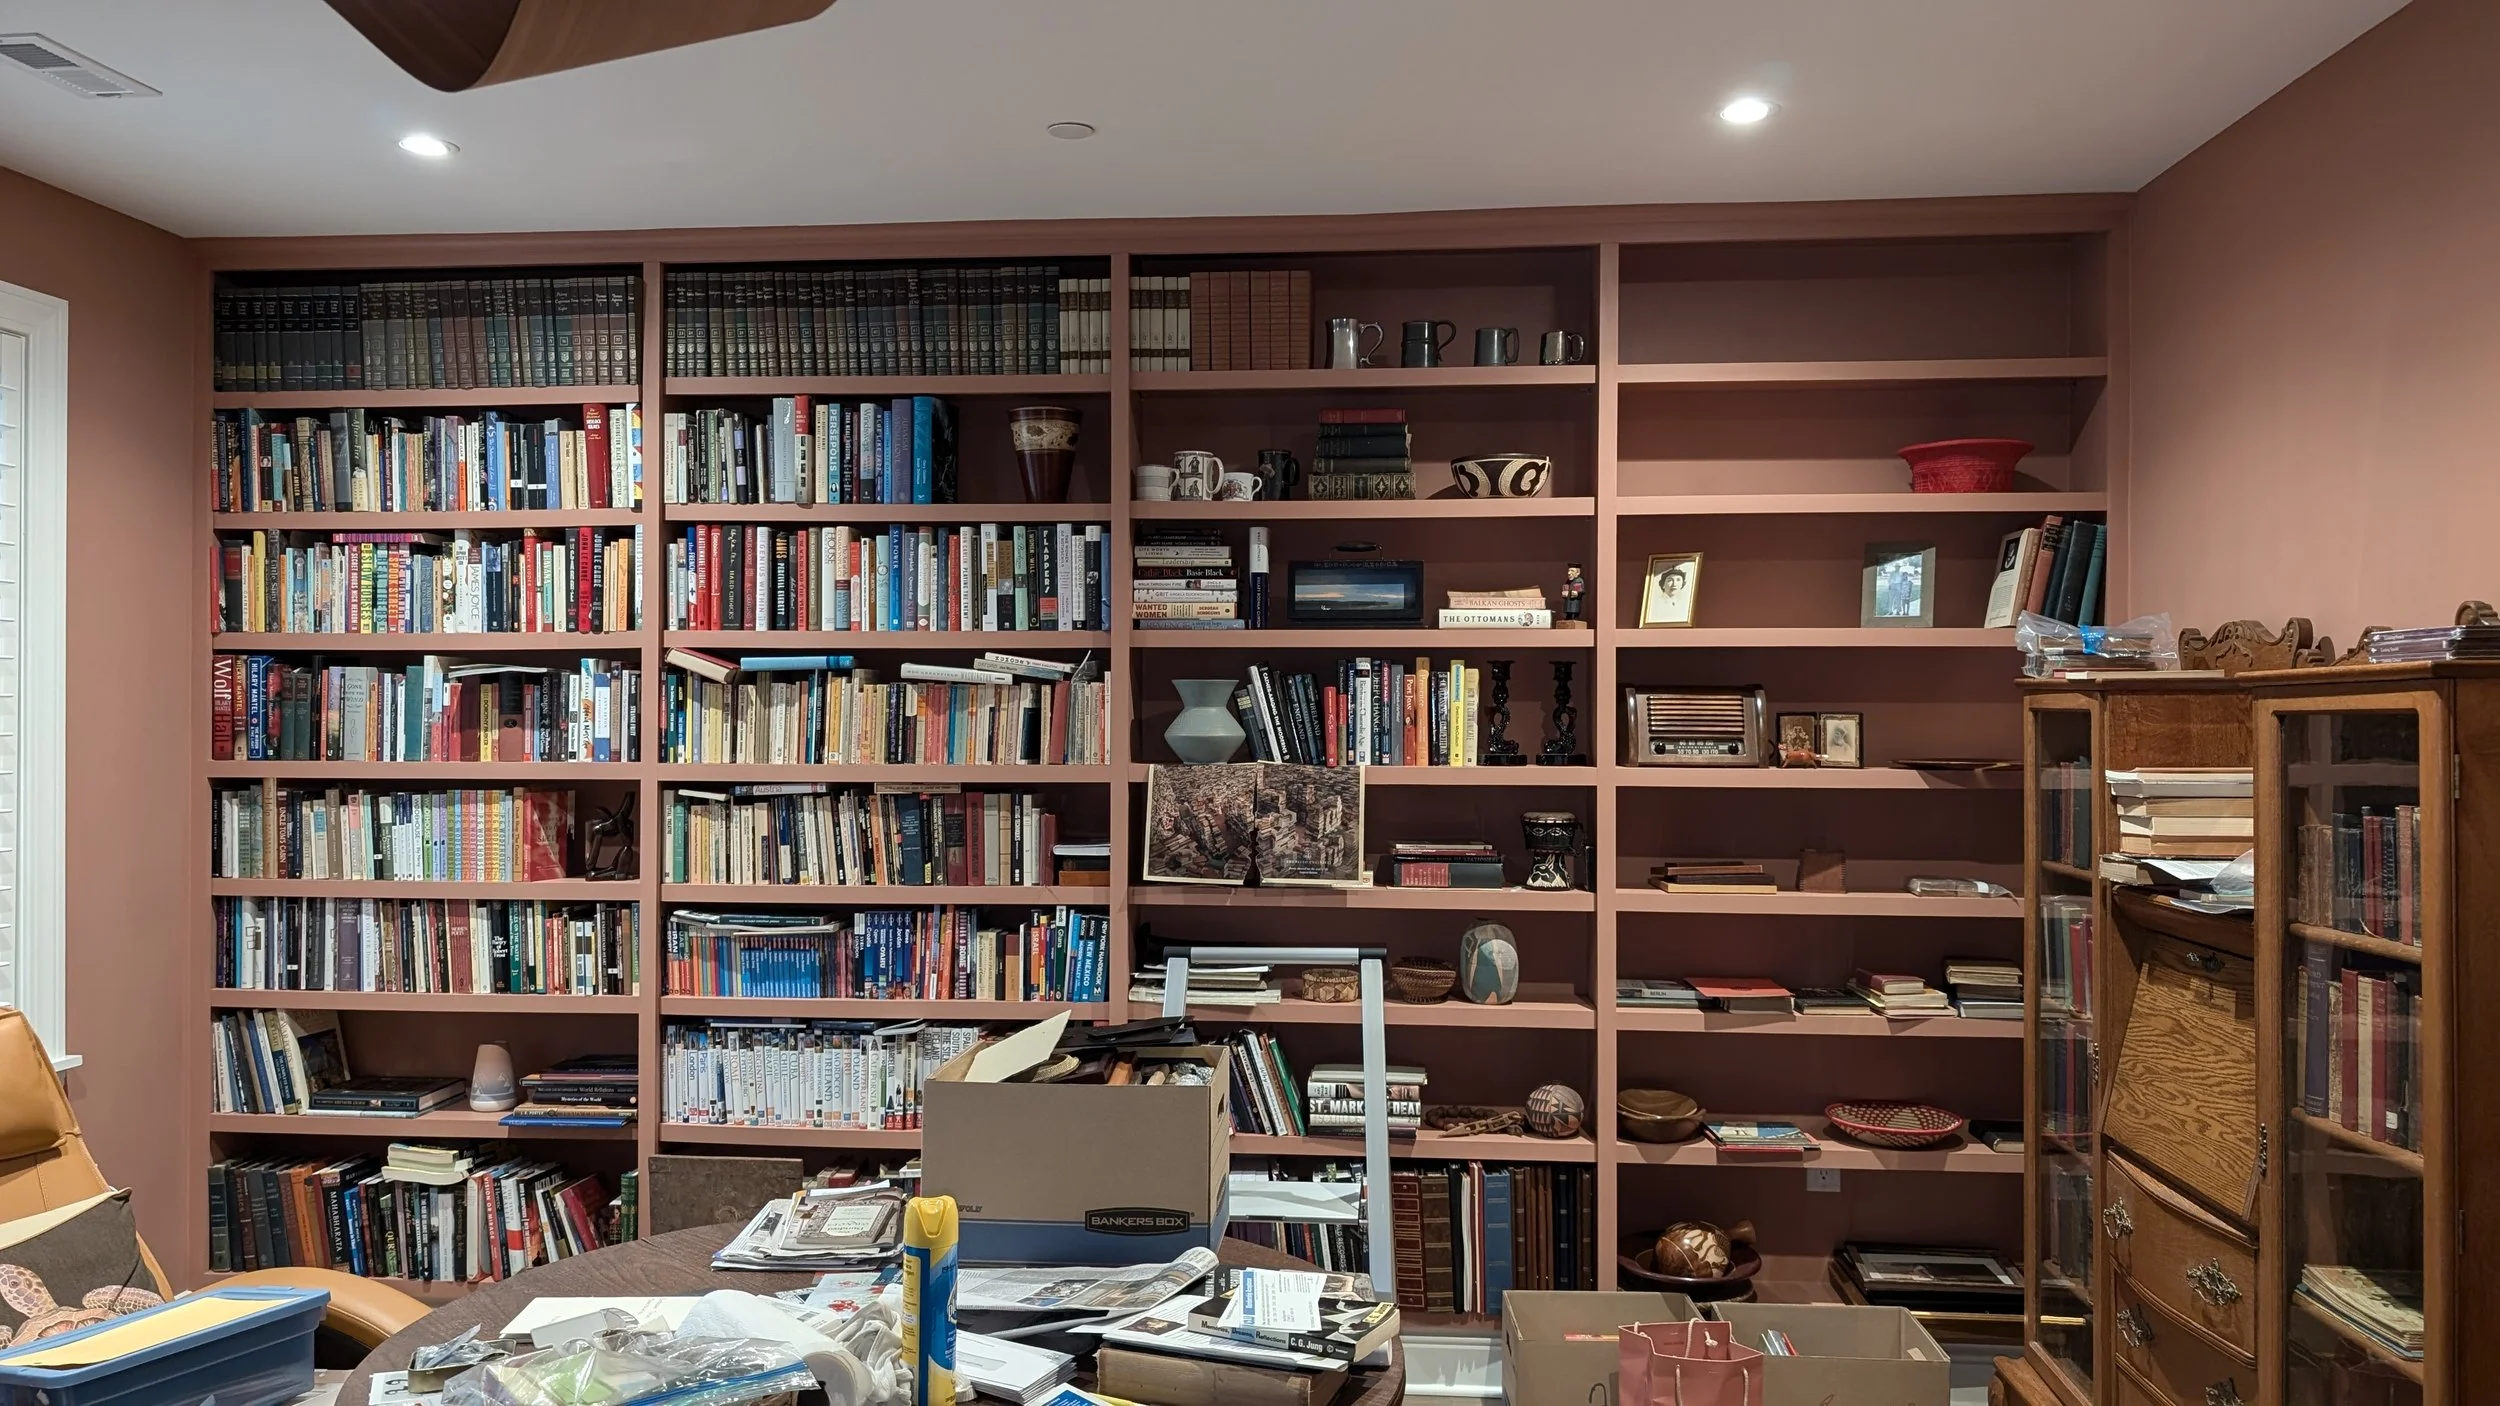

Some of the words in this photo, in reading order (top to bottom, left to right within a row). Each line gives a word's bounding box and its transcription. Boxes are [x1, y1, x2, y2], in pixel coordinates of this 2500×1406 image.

[351, 418, 360, 439] After
[829, 408, 838, 472] PERSEPOLIS
[862, 408, 872, 452] Windswept
[352, 444, 361, 460] Fire
[581, 534, 589, 553] JOHN
[593, 534, 602, 554] JOHN
[775, 537, 787, 559] JAMES
[827, 531, 836, 565] HOUSE
[892, 529, 900, 542] SEA
[908, 537, 916, 550] Peter
[360, 555, 371, 582] SLOW
[581, 554, 589, 563] LE
[594, 555, 602, 563] LE
[892, 542, 900, 569] POWER
[907, 551, 916, 572] Hopkirk
[270, 559, 280, 580] Little
[375, 556, 386, 582] REAL
[388, 556, 398, 585] SPOOK
[470, 565, 481, 592] JAMES
[543, 554, 552, 585] HAVANA
[776, 562, 785, 589] PERCIVAL
[1186, 568, 1204, 577] Basic
[1205, 568, 1224, 577] Black
[270, 582, 280, 602] Saint
[361, 584, 372, 621] HORSES
[376, 585, 387, 623] TIGERS
[388, 587, 399, 620] STREET
[776, 590, 785, 616] EVERETT
[470, 592, 480, 620] JOYCE
[214, 659, 232, 700] Wolf
[250, 662, 258, 688] HILARY
[1372, 672, 1382, 695] DEEP
[251, 689, 259, 715] MANTEL
[1372, 695, 1382, 733] CHANGE
[1406, 695, 1414, 711] JOAN
[214, 714, 231, 743] Hall
[1267, 693, 1278, 715] AMONG
[1274, 726, 1288, 754] MODERNS
[1292, 703, 1305, 740] ENGLAND
[1309, 702, 1321, 736] IRELAND
[754, 784, 783, 794] Austria
[264, 796, 273, 817] Help
[514, 924, 519, 932] ON
[1057, 928, 1065, 948] Ghana
[1032, 930, 1040, 956] ISRAEL
[1085, 941, 1094, 959] NEW
[1098, 935, 1107, 951] YORK
[1083, 960, 1092, 987] MEXICO
[1095, 951, 1106, 986] HANDBOOK
[931, 1031, 941, 1060] ICELAND
[942, 1031, 951, 1045] THE
[952, 1031, 960, 1054] SOUTH
[731, 1054, 739, 1083] ROME
[755, 1048, 764, 1094] ARGENTINA
[790, 1053, 798, 1080] CUBA
[833, 1052, 841, 1099] MOROCCO
[844, 1051, 852, 1076] PERU
[824, 1057, 832, 1102] IRELAND
[869, 1052, 879, 1104] CALIFORNIA
[1330, 1100, 1364, 1114] MARK
[330, 1190, 344, 1253] MAHABHARATA
[486, 1204, 492, 1216] OR
[1091, 1216, 1154, 1226] BANKERS
[1156, 1217, 1184, 1227] BOX
[487, 1217, 495, 1240] MIRAGE
[1201, 1320, 1231, 1335] Memories,
[1255, 1331, 1287, 1345] Reflections
[1290, 1337, 1298, 1347] C.
[1298, 1339, 1305, 1348] G.
[1306, 1340, 1323, 1352] Jung
